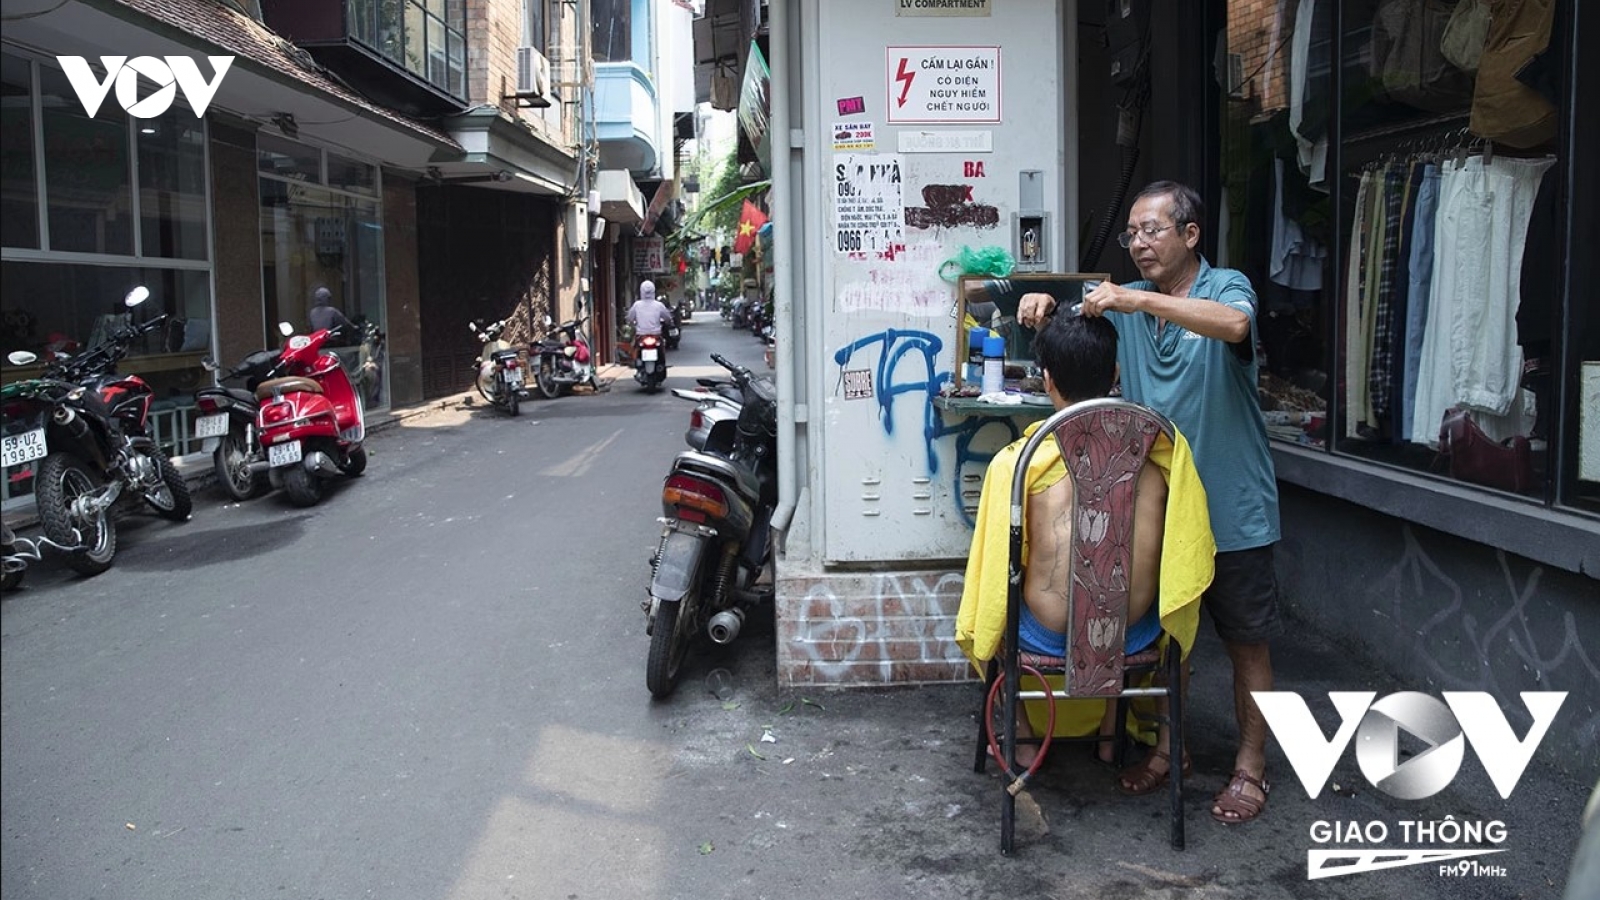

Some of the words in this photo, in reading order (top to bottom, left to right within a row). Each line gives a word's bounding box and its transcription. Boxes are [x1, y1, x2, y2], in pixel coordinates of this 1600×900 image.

[946, 58, 963, 72] LẠI
[929, 88, 958, 98] NGUY
[964, 161, 985, 178] BA
[838, 230, 861, 252] 0966
[4, 432, 37, 452] 59-U2
